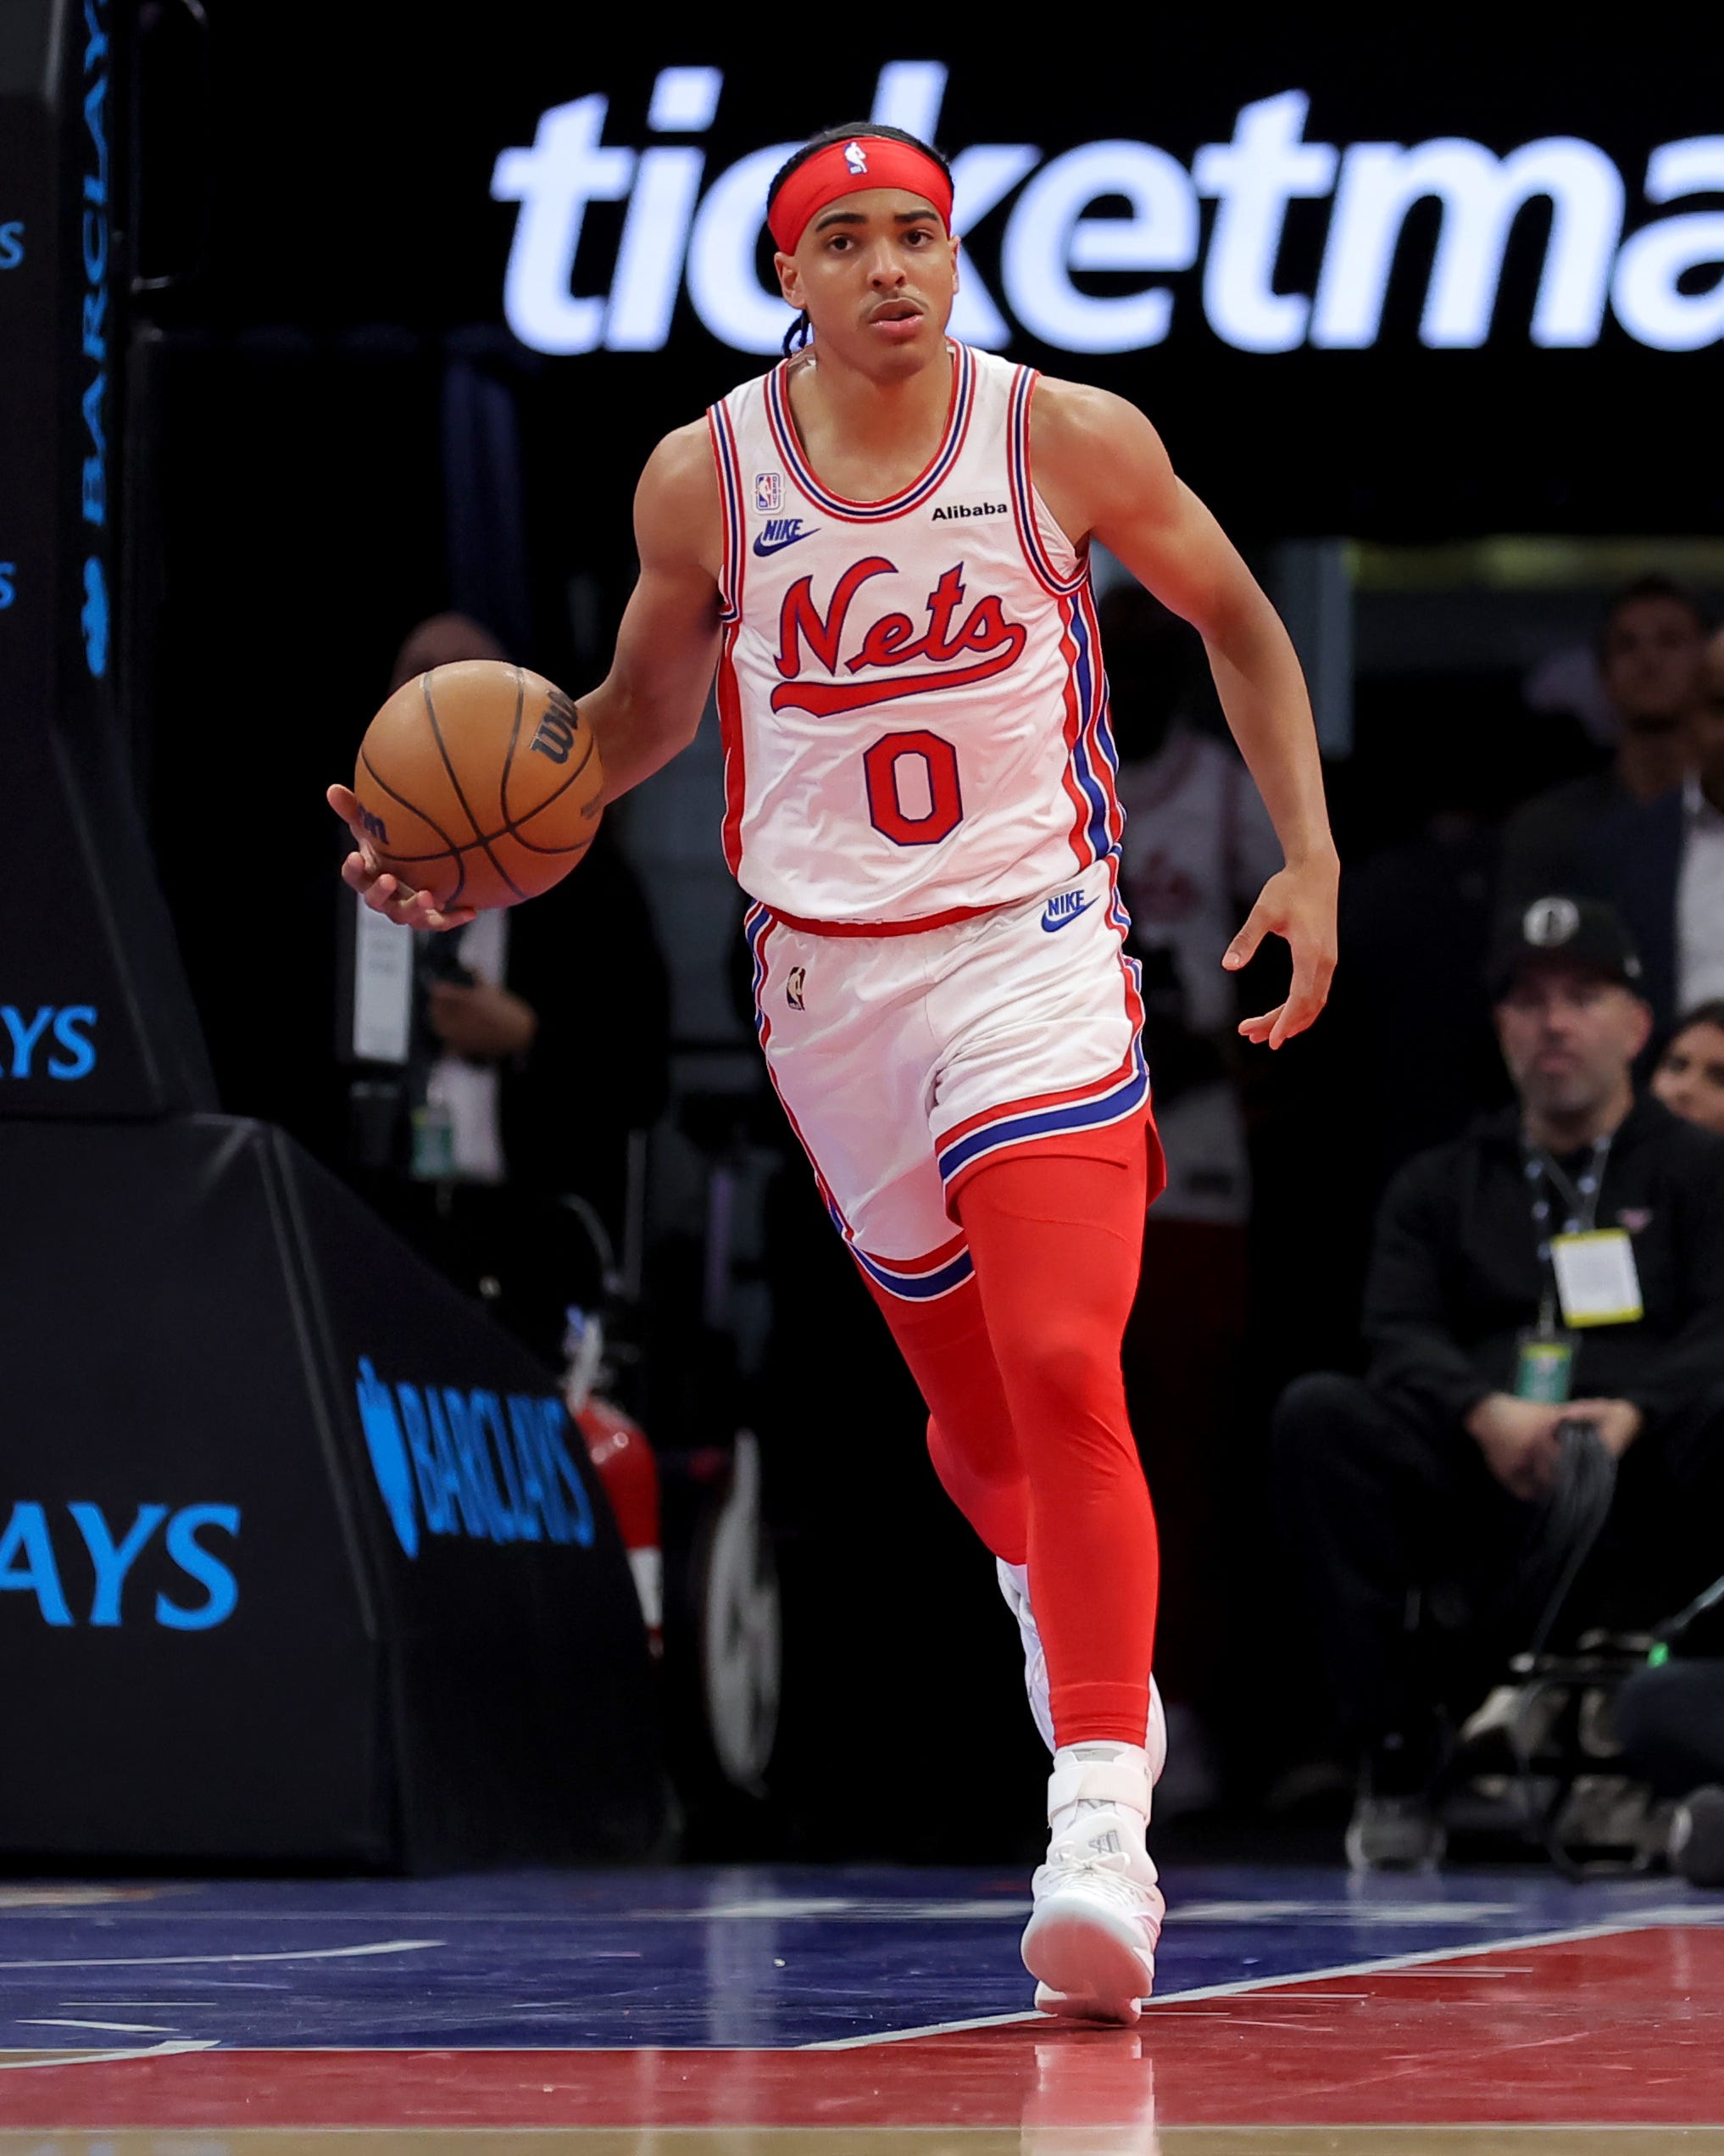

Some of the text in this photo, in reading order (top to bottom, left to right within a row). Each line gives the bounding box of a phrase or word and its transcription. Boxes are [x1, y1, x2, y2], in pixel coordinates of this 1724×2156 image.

[763, 518, 804, 541] NIKE
[932, 502, 1008, 521] Alibaba
[770, 555, 1026, 718] Nets
[863, 729, 964, 847] 0
[1048, 889, 1085, 916] NIKE
[395, 1380, 596, 1549] BARCLAYS
